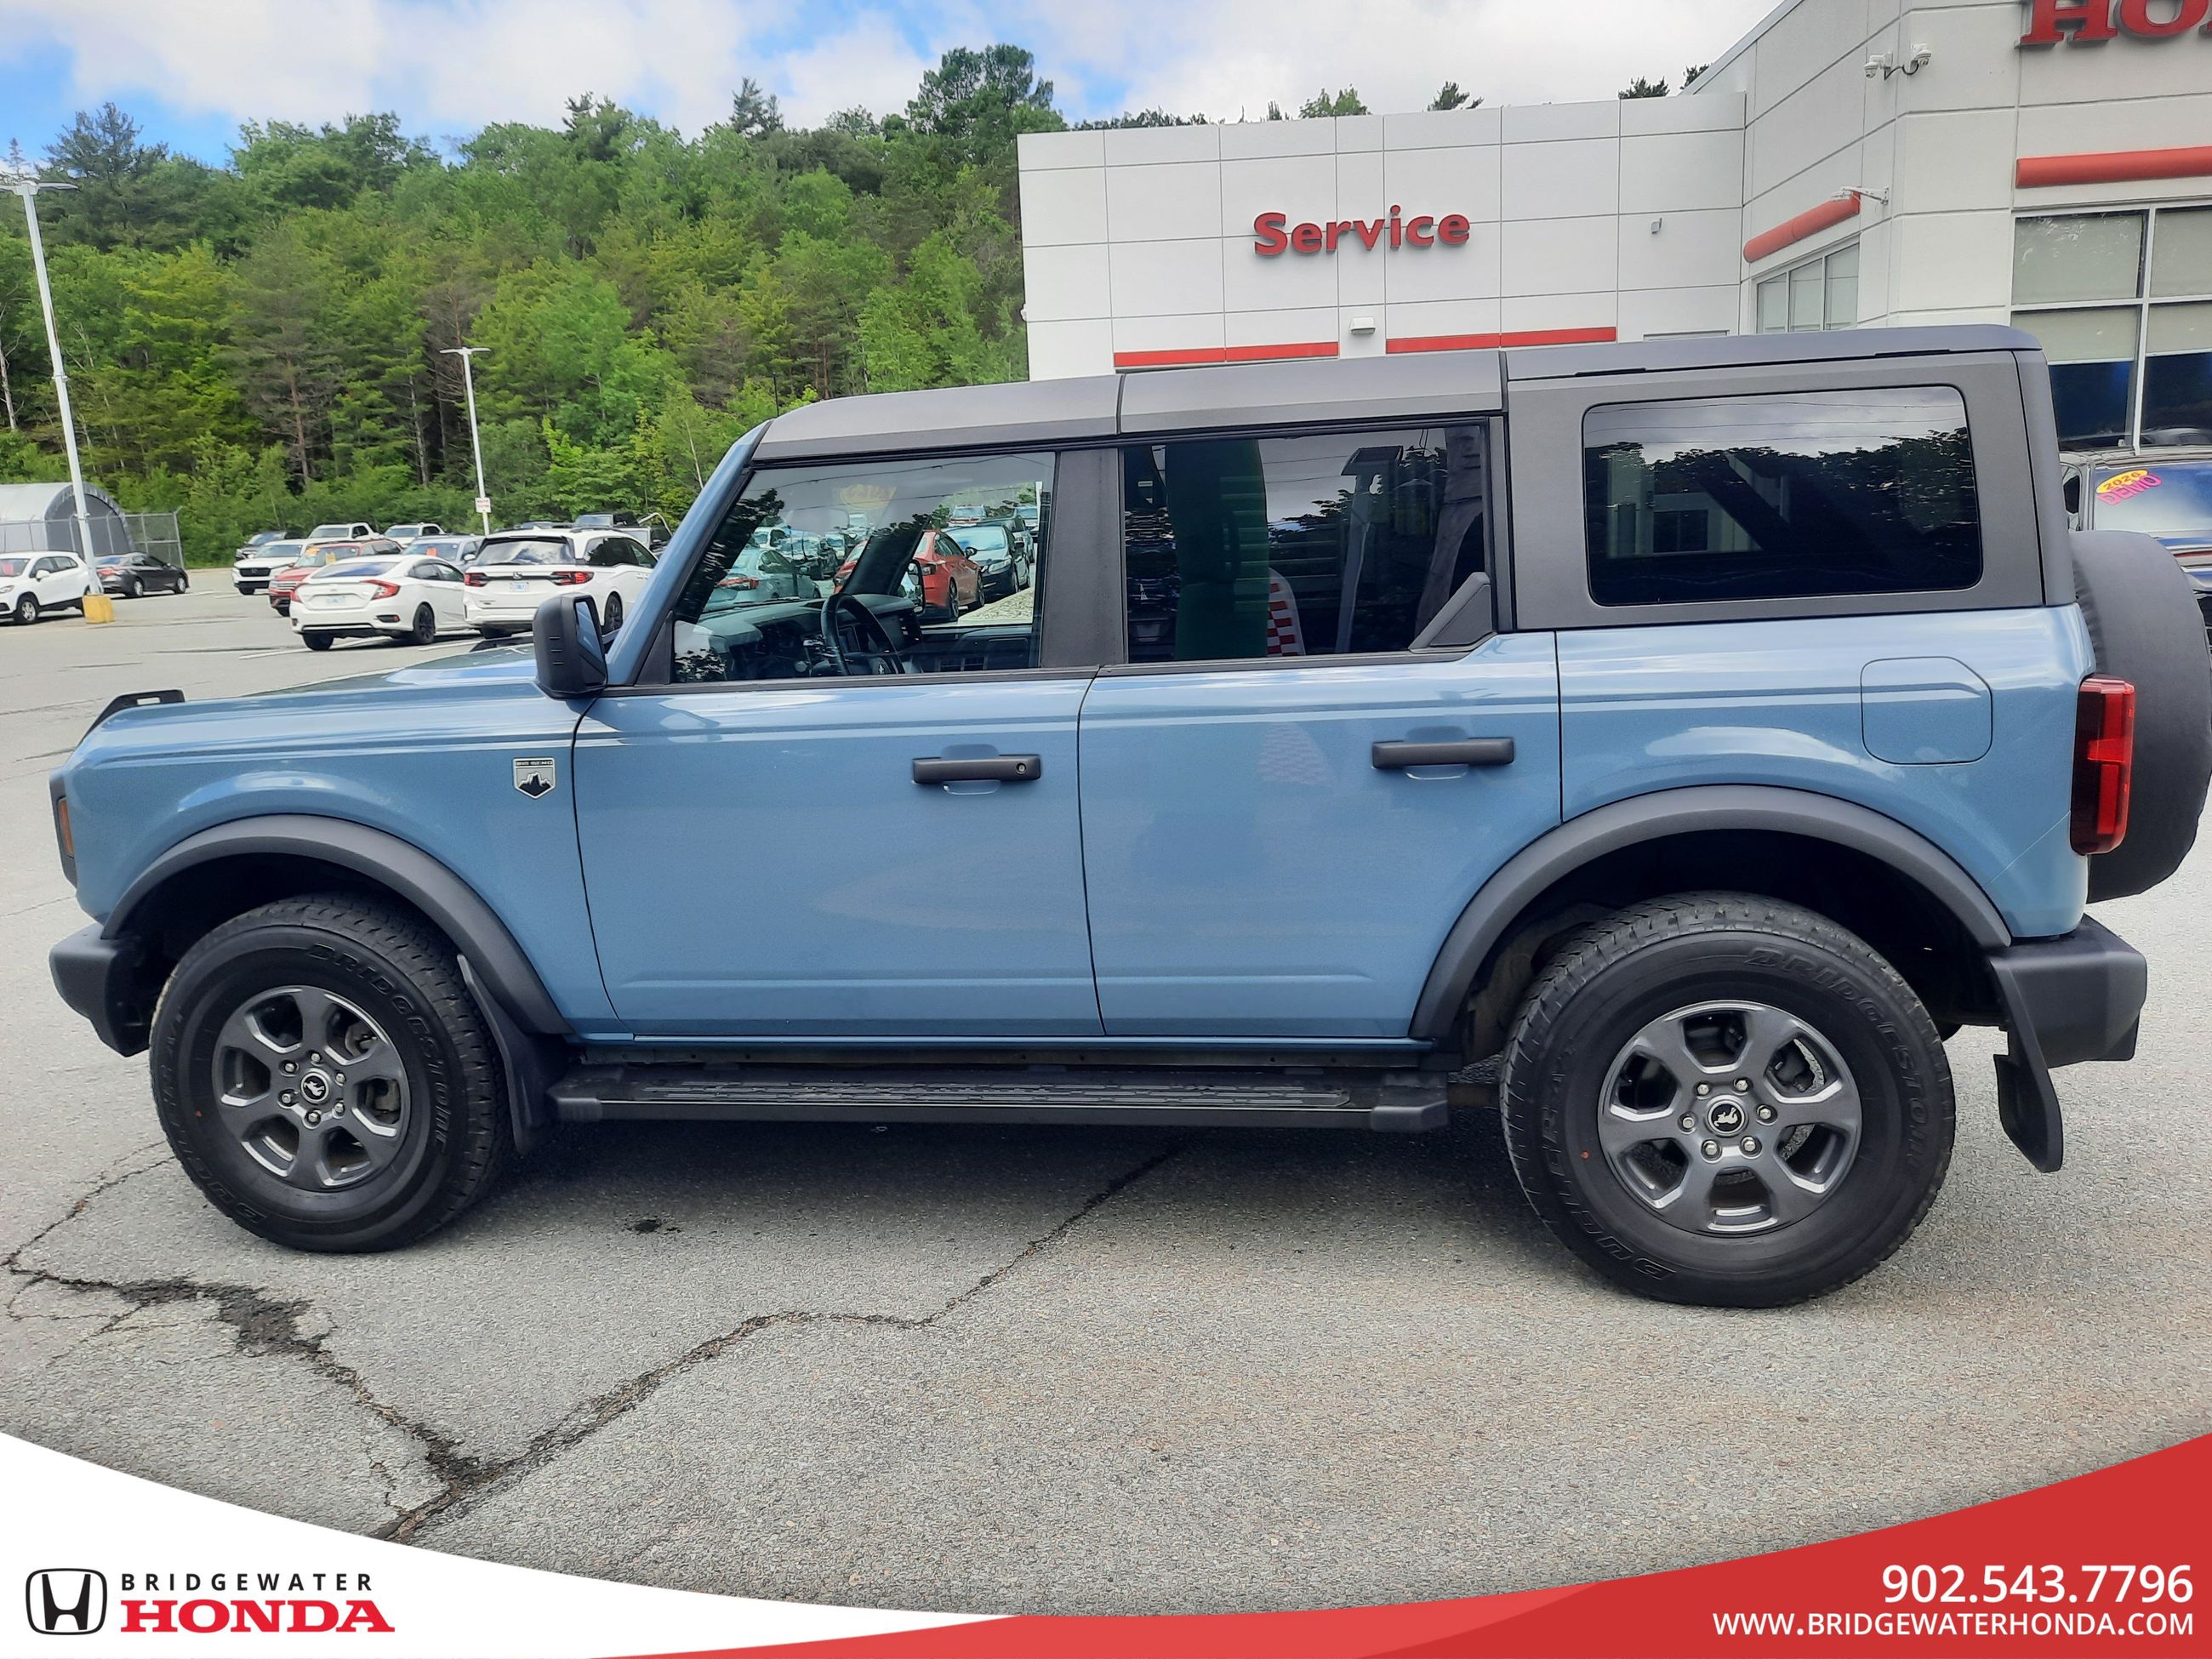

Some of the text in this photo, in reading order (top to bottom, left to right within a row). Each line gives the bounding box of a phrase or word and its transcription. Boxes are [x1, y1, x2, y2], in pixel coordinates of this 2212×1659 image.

[2020, 0, 2212, 47] HO
[1255, 205, 1469, 255] Service
[2096, 474, 2162, 505] DEMO
